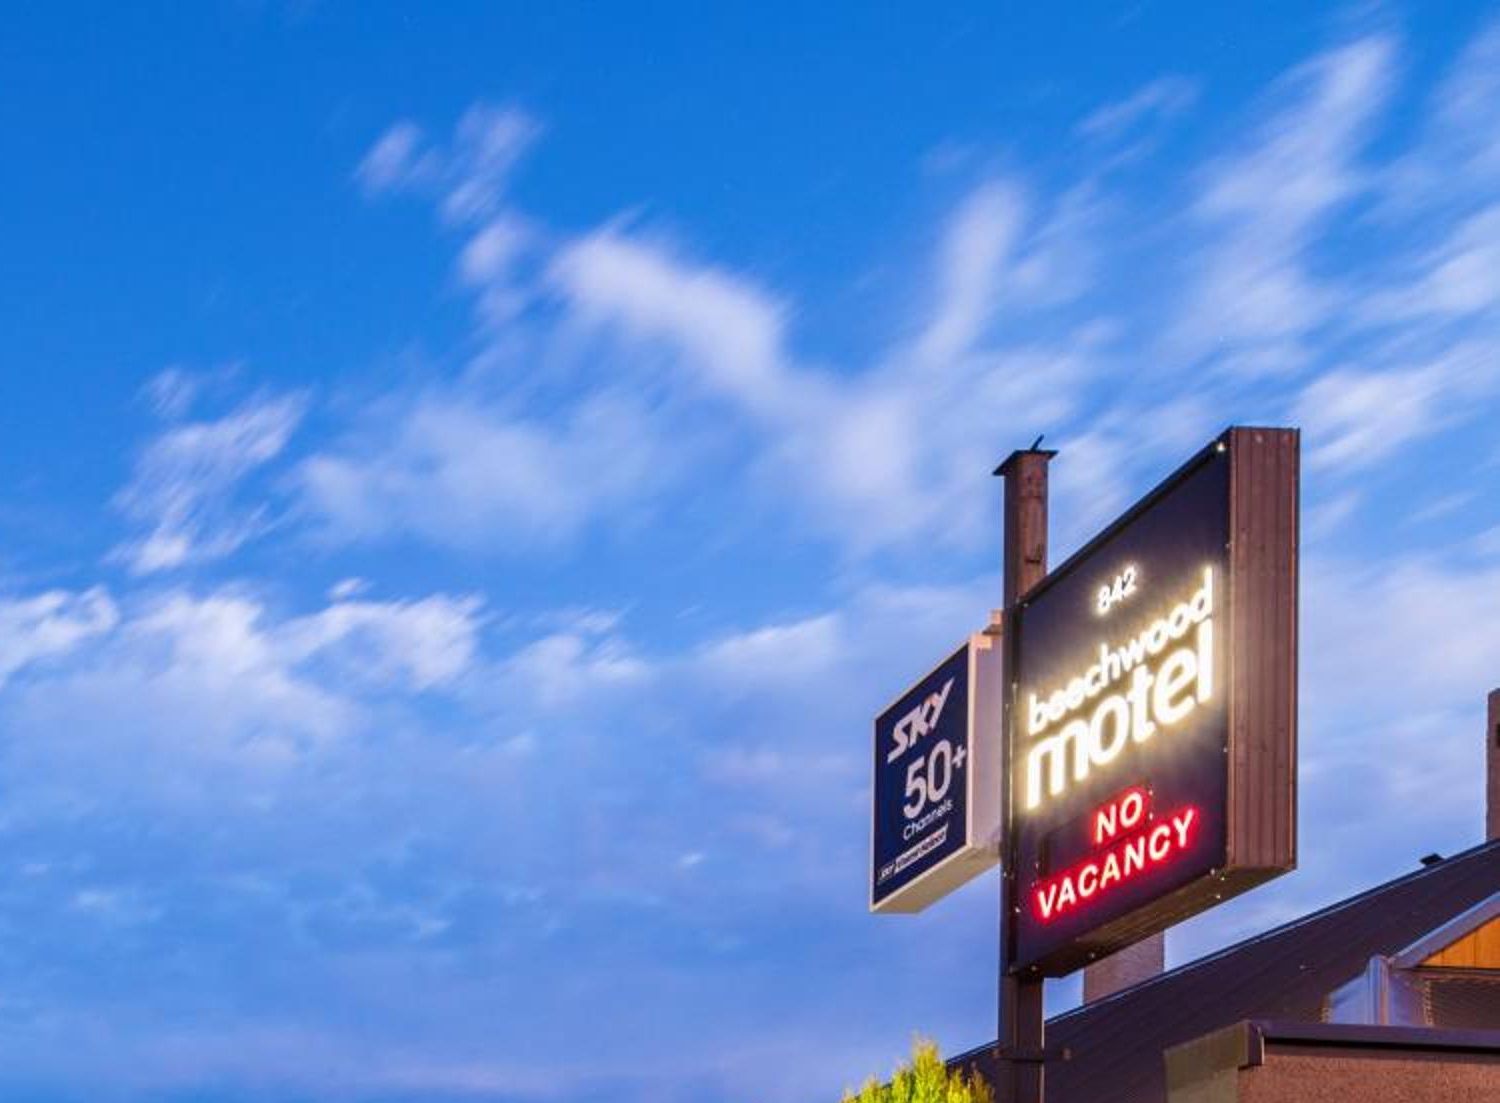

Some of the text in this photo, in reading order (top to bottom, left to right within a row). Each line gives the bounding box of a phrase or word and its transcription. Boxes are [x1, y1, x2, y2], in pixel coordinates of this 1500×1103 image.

[1096, 565, 1138, 614] 842
[1028, 566, 1213, 735] beechwood
[887, 677, 955, 763] SKY
[1027, 618, 1213, 810] motel
[903, 739, 967, 819] 50+
[1096, 792, 1143, 843] NO
[1037, 810, 1194, 918] VACANCY
